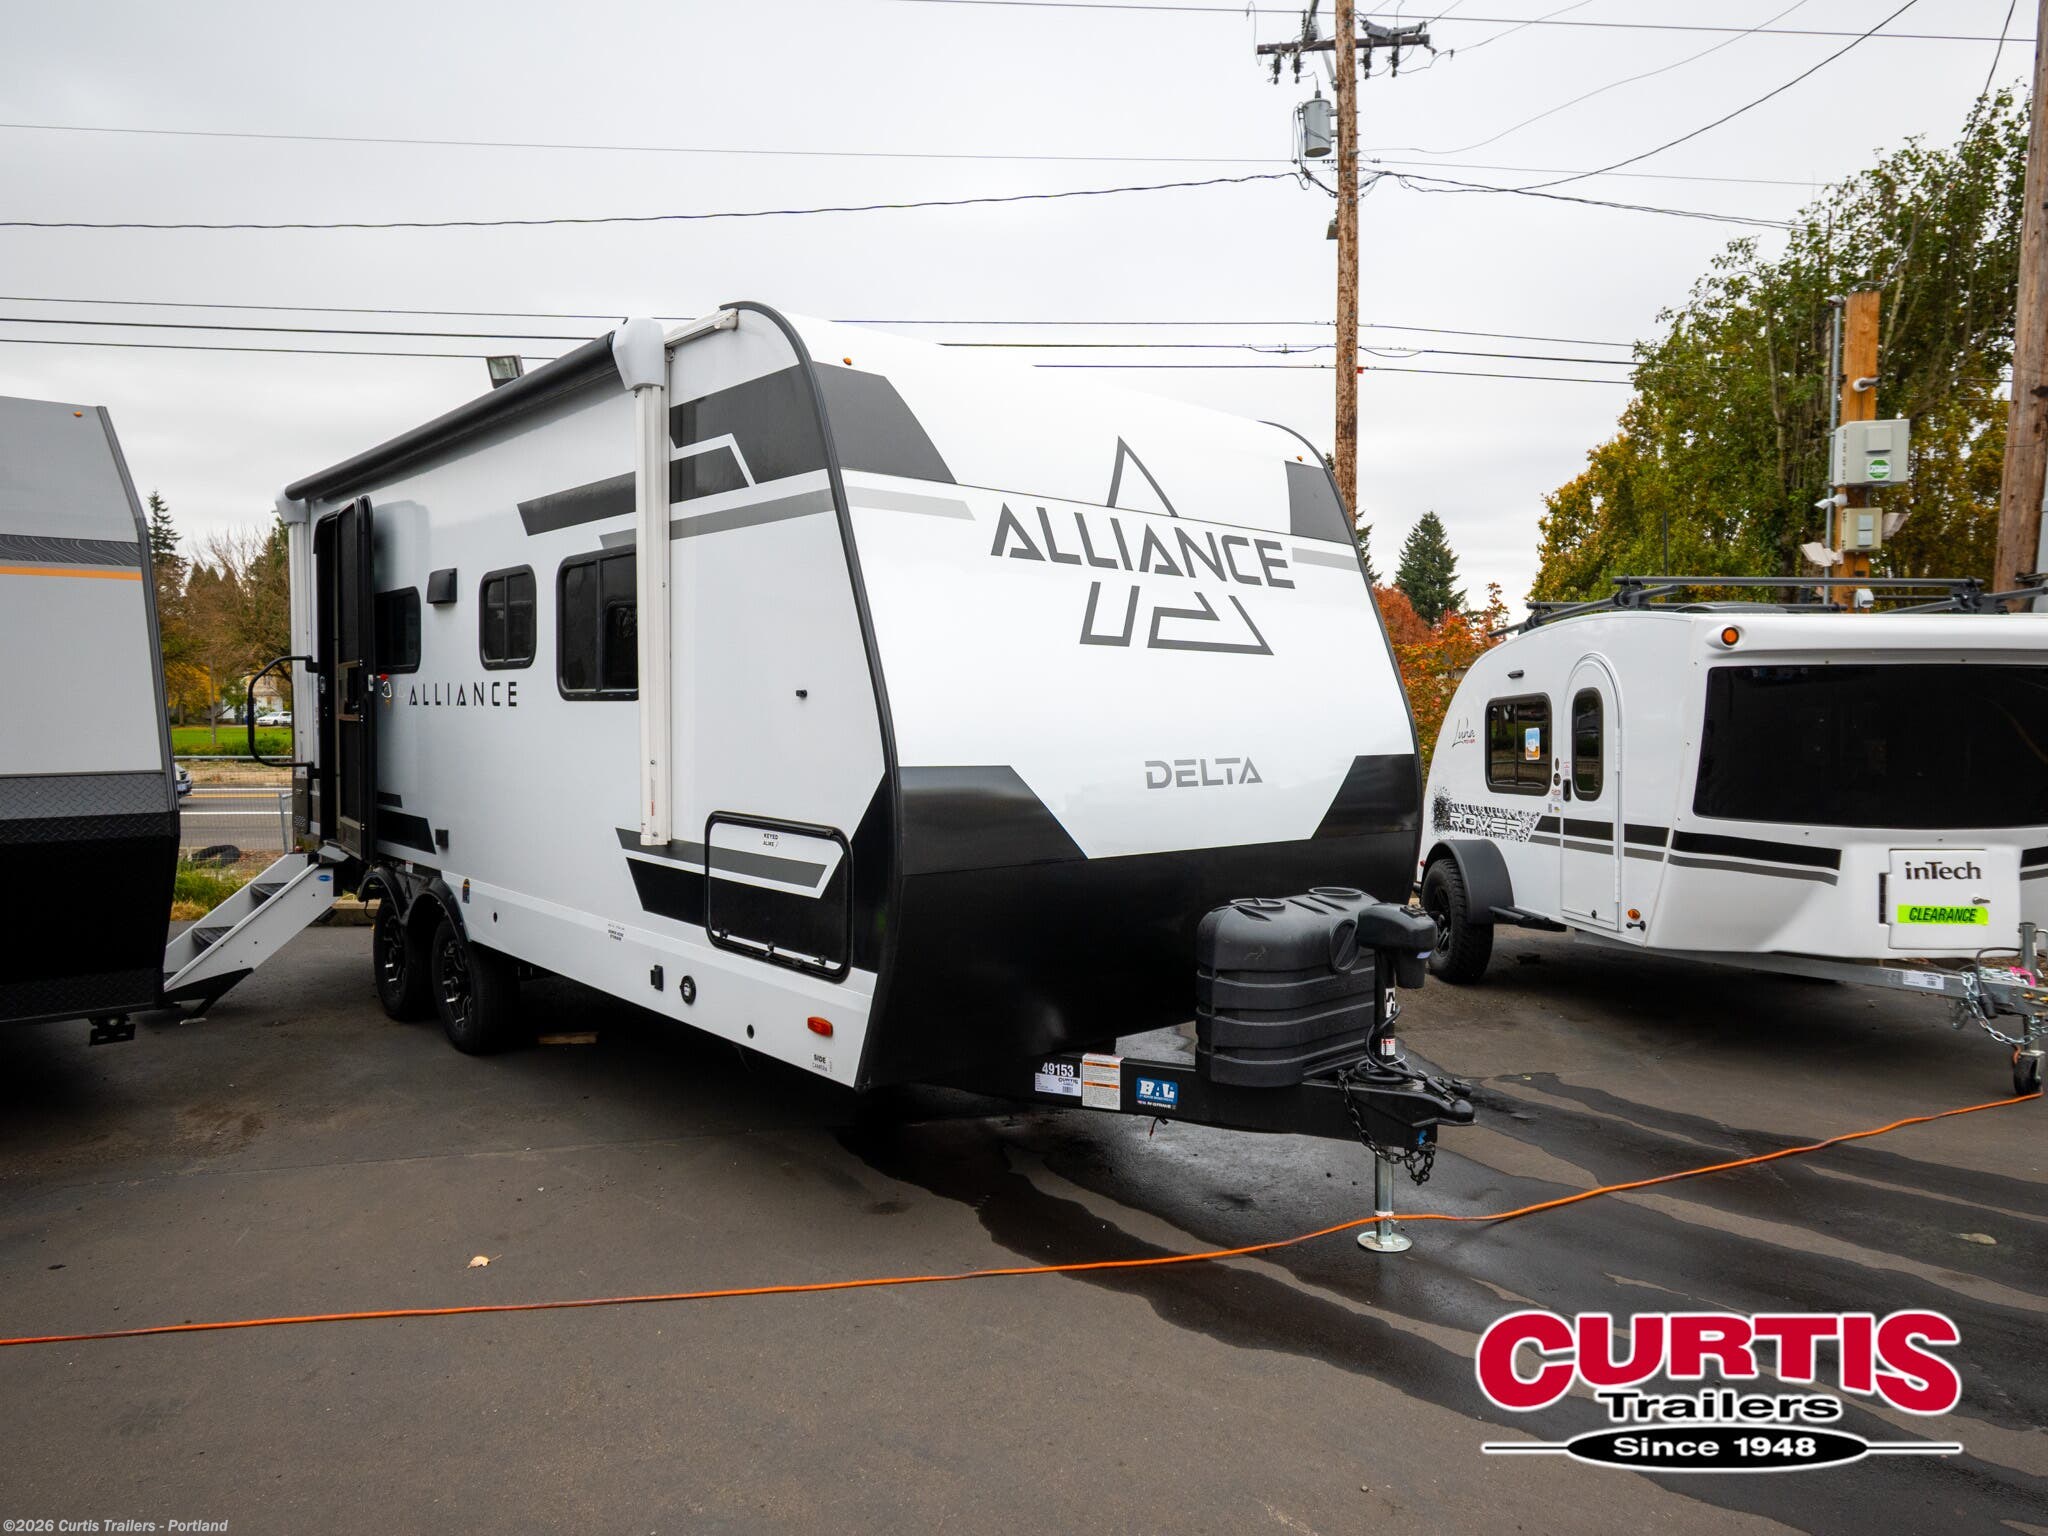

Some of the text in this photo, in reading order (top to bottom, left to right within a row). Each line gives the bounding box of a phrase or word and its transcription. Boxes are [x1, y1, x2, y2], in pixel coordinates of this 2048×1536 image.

[990, 502, 1296, 590] ALLIANCE
[408, 681, 518, 707] ALLIANCE
[1145, 756, 1263, 789] DELTA
[1449, 811, 1523, 840] ROVER
[1905, 861, 1982, 880] inTech
[1908, 907, 1978, 922] CLEARANCE
[1042, 1062, 1075, 1077] 49153
